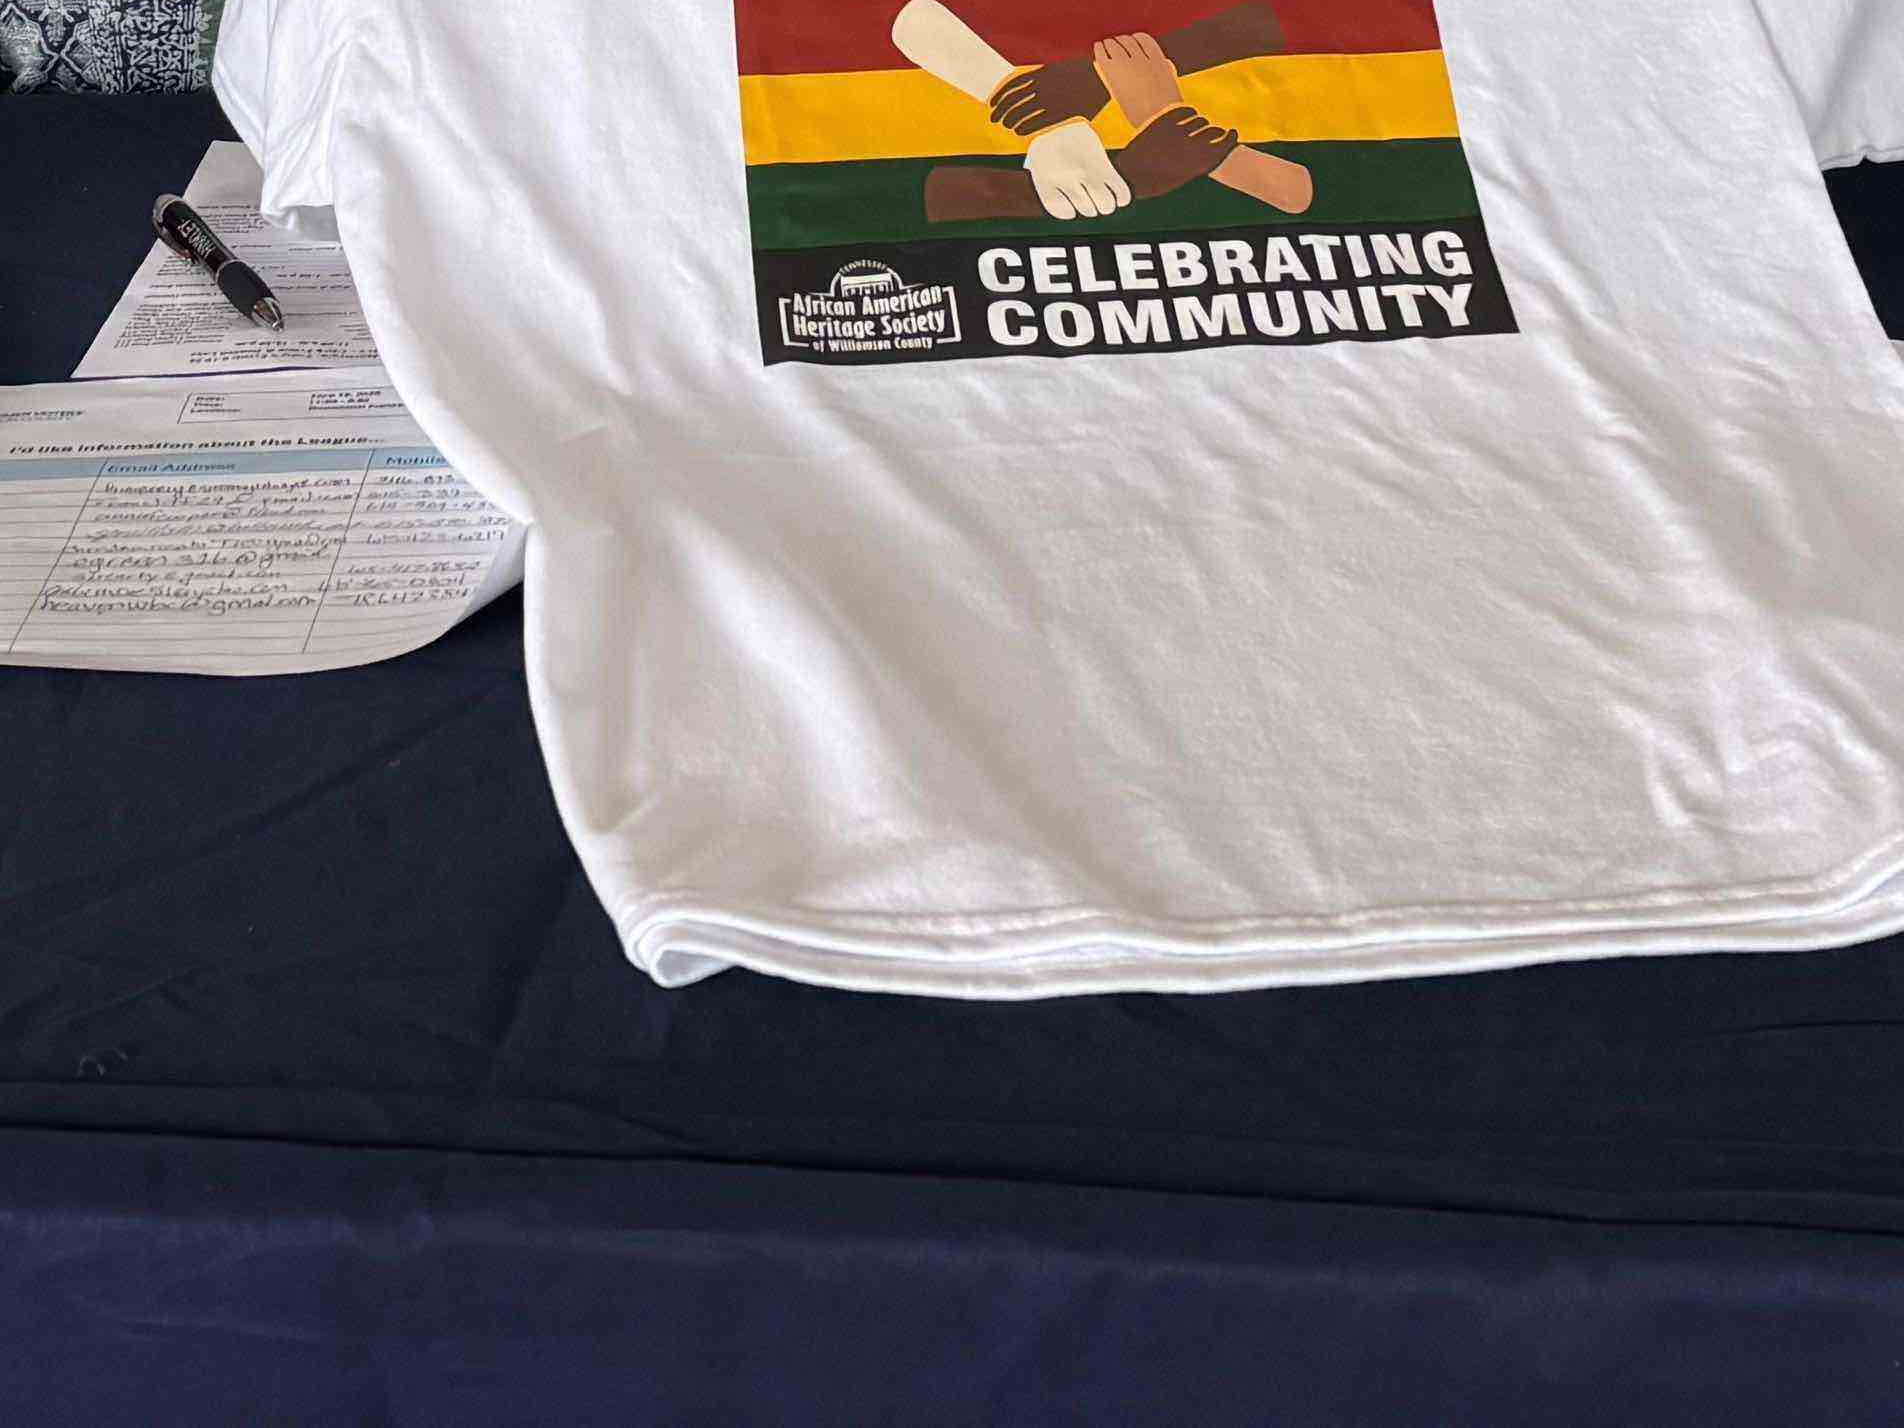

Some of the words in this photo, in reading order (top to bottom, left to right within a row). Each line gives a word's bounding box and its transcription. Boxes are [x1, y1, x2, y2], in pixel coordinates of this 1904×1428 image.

[978, 230, 1474, 296] CELEBRATING
[793, 293, 856, 317] African
[862, 285, 943, 316] American
[986, 284, 1475, 347] COMMUNITY
[792, 313, 876, 339] Heritage
[881, 308, 946, 335] Society
[812, 341, 825, 353] of
[828, 338, 892, 352] Williamson
[894, 335, 933, 350] County
